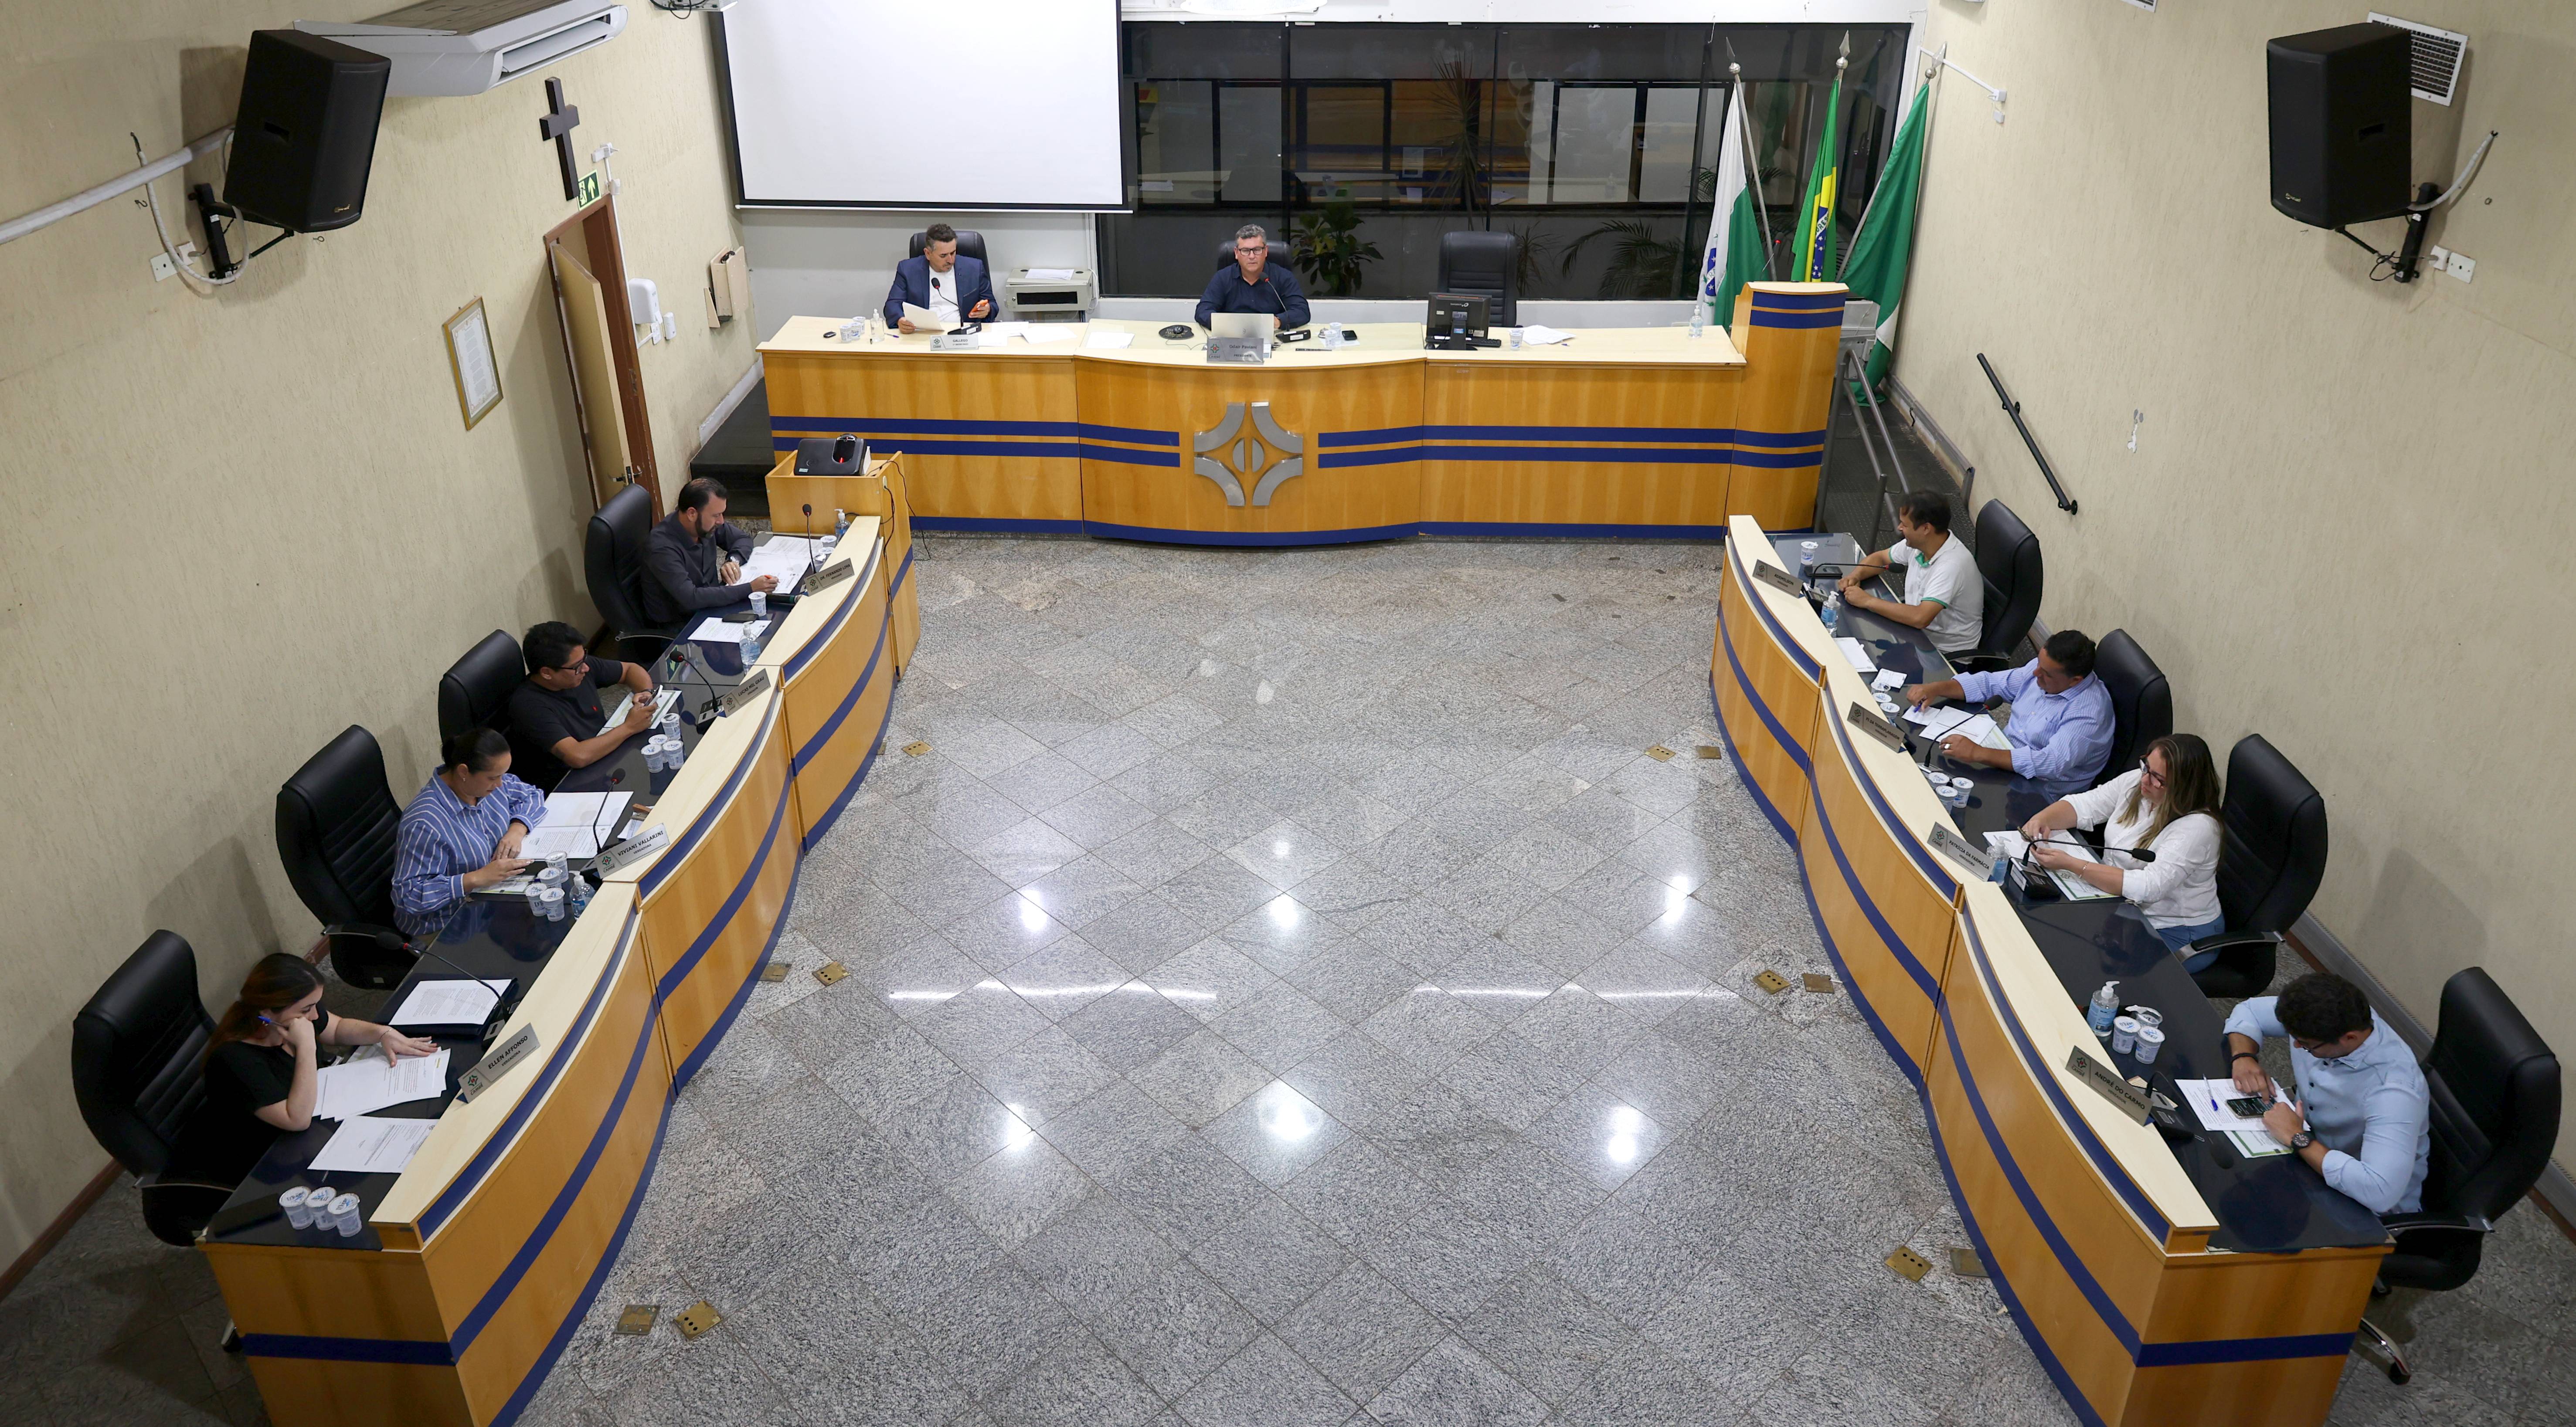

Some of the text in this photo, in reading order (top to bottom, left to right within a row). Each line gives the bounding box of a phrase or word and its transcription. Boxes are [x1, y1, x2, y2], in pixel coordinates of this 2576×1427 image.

[738, 687, 749, 697] LUCAS
[755, 676, 765, 685] GRAU
[617, 831, 663, 856] VIVIANI VALLARINI
[633, 844, 652, 855] VEREADORA
[1971, 855, 1989, 870] FARMÁCIA
[488, 1035, 528, 1070] ELLEN AFFONSO
[501, 1051, 521, 1067] VEREADORA
[2094, 1071, 2114, 1088] ANDRÉ
[2124, 1093, 2145, 1110] CARMO
